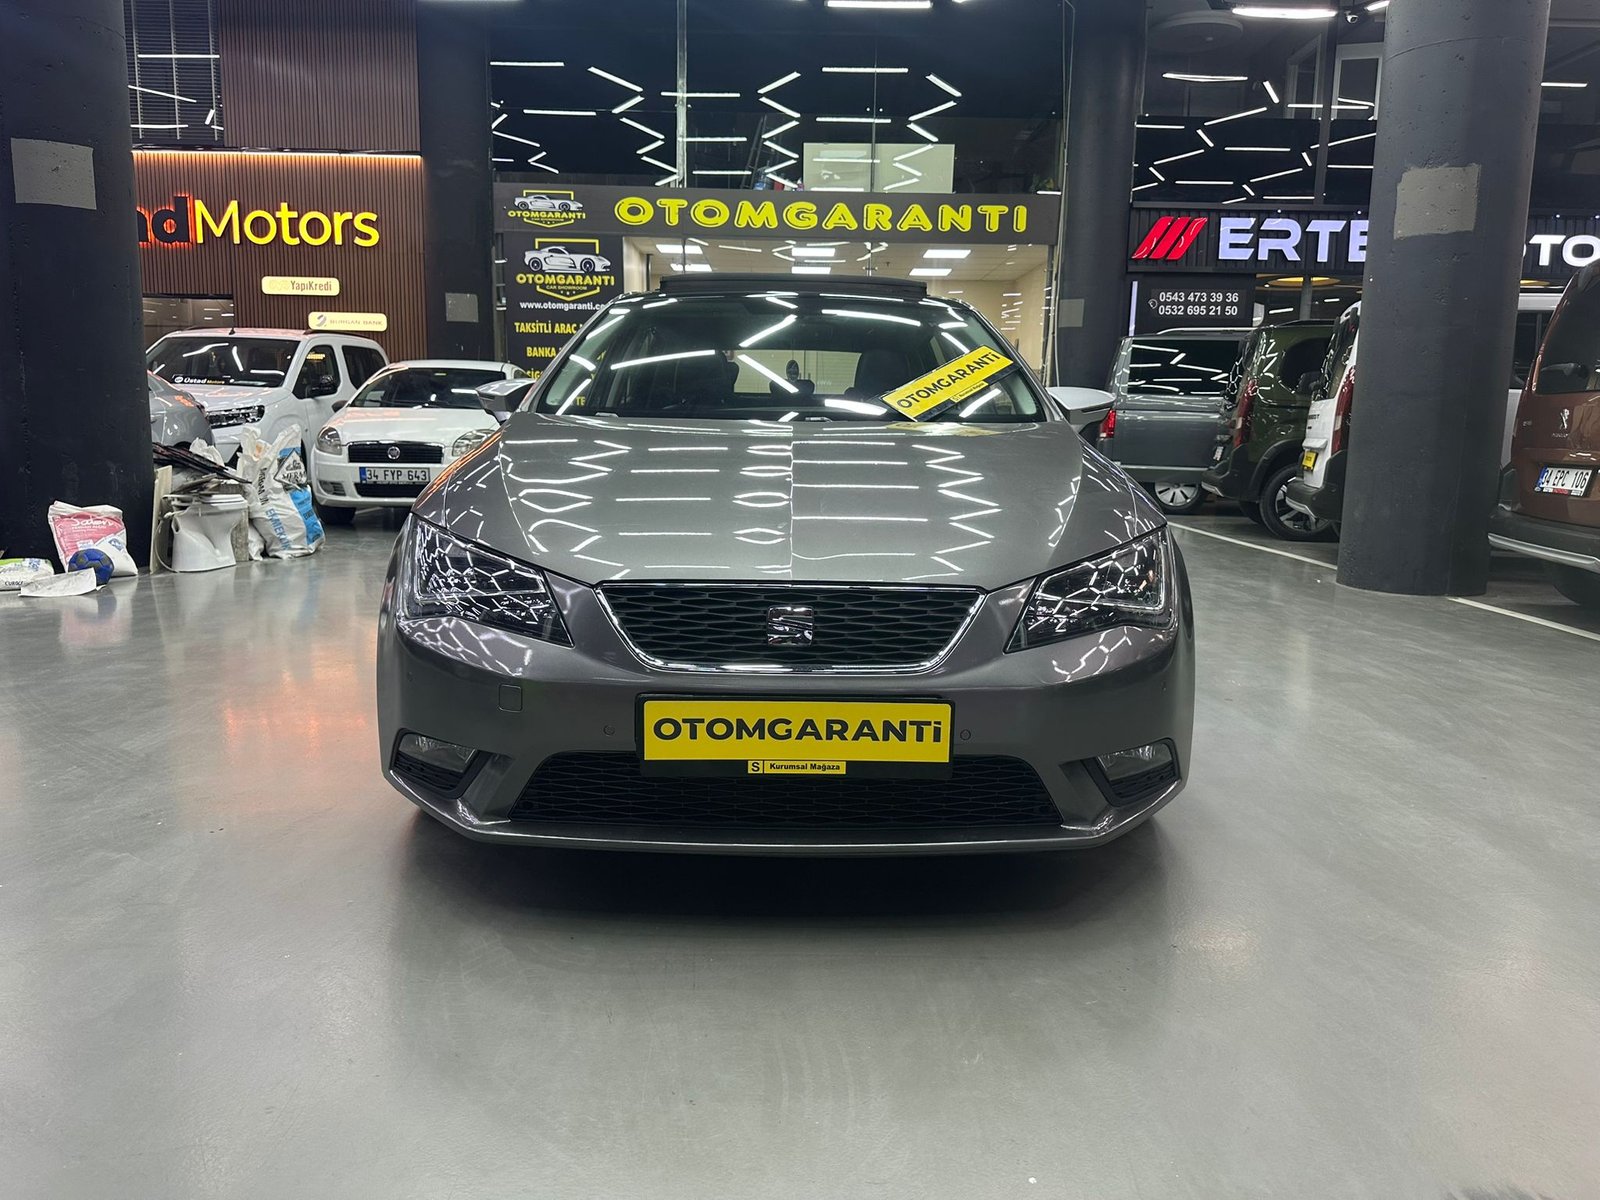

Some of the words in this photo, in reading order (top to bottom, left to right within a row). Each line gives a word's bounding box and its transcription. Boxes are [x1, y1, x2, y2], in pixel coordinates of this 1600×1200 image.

[508, 210, 586, 219] OTOMGARANTI
[614, 196, 1028, 233] OTOMGARANTI
[516, 273, 615, 286] OTOMGARANTI
[1159, 292, 1185, 302] 0543
[1187, 292, 1207, 303] 473
[1210, 292, 1223, 303] 39
[1225, 293, 1239, 303] 36
[1158, 305, 1184, 316] 0532
[1187, 305, 1207, 316] 695
[1209, 306, 1221, 316] 21
[1224, 306, 1238, 316] 50
[514, 320, 552, 334] TAKSİTLİ
[526, 347, 557, 358] BANKA
[366, 469, 378, 480] 34
[384, 469, 403, 480] FYP
[408, 470, 427, 481] 643
[769, 762, 808, 771] Kurumsal
[810, 763, 841, 772] Mağaza
